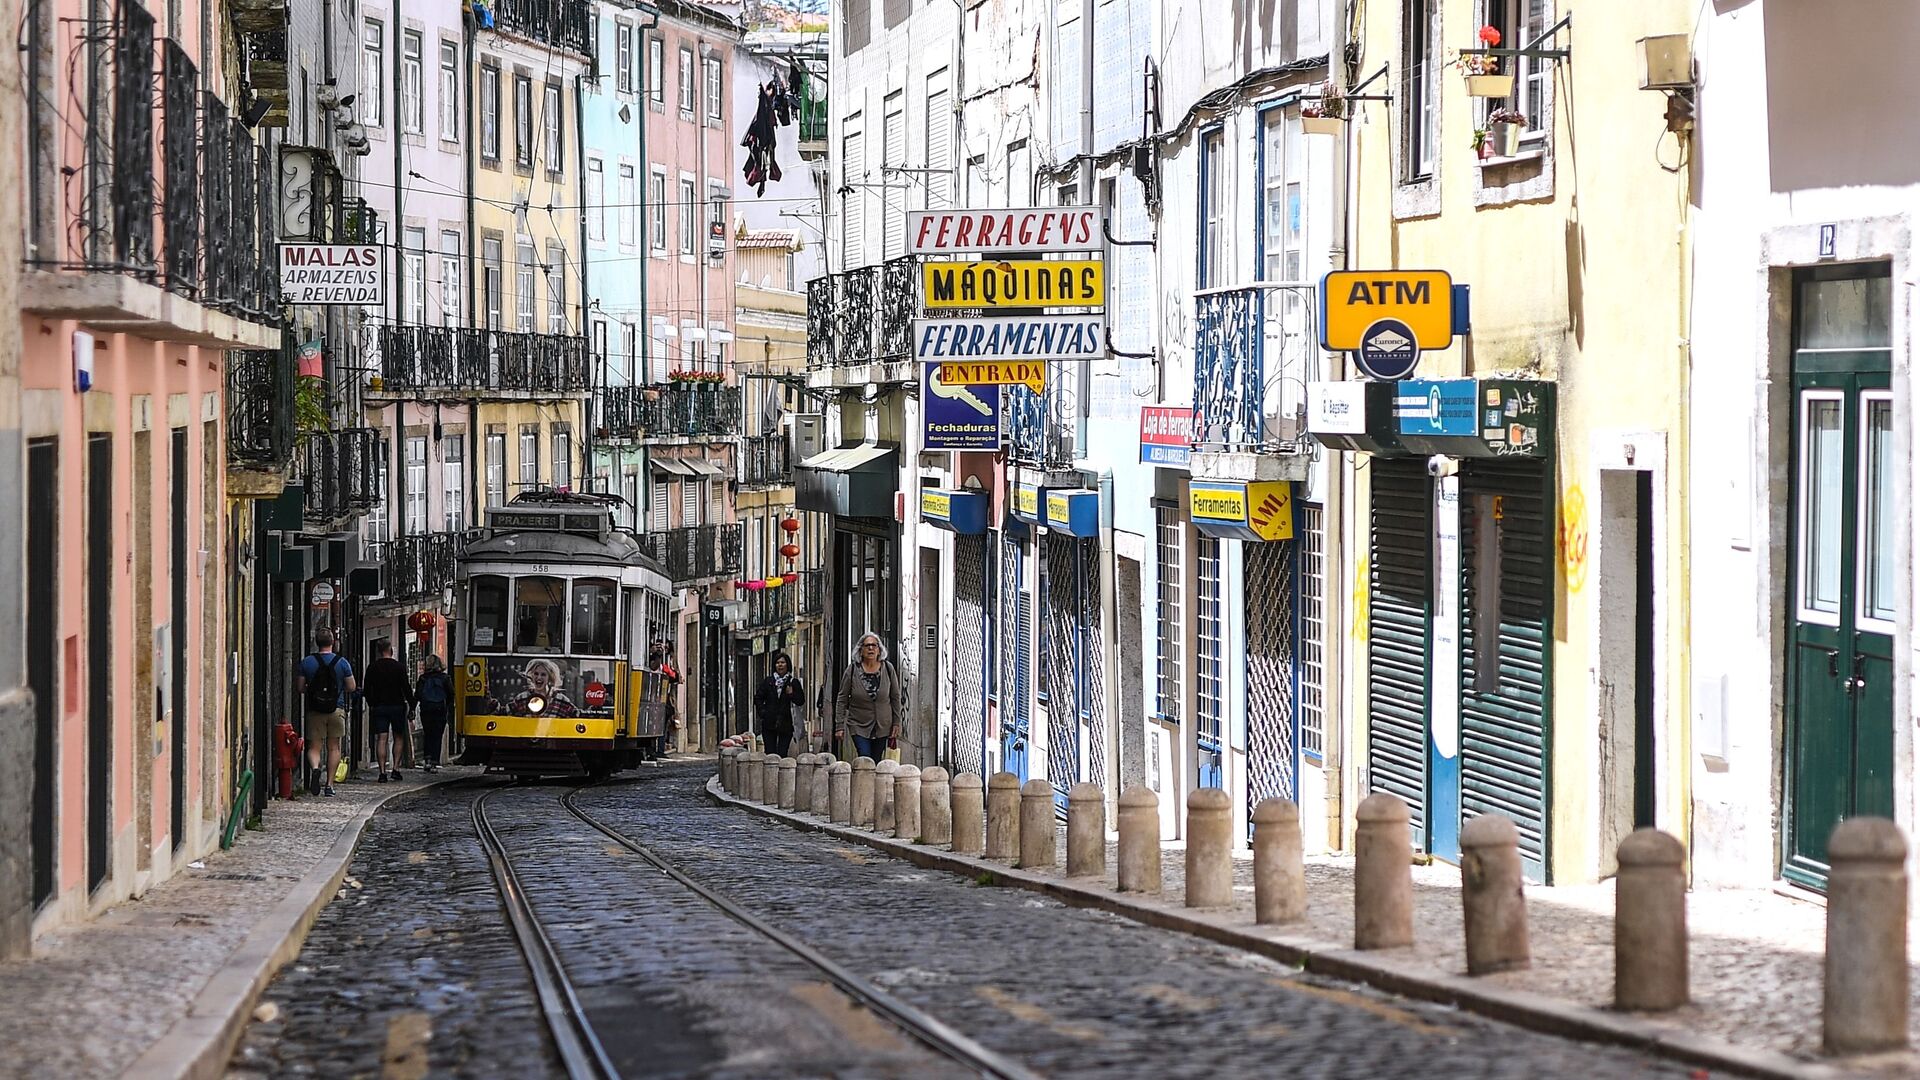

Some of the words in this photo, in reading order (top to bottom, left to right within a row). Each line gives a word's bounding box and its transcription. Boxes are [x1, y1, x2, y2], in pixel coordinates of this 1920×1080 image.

[916, 212, 1094, 248] FERRAGENS
[1823, 226, 1833, 254] 12
[285, 248, 377, 267] MALAS
[285, 270, 378, 284] ARMAZENS
[933, 263, 1095, 304] MÁQUINAS
[302, 287, 378, 302] REVENDA
[1347, 281, 1430, 305] ATM
[918, 322, 1100, 357] FERRAMENTAS
[1374, 337, 1404, 345] Euronet
[942, 364, 1042, 382] ENTRADA
[928, 423, 997, 432] Fechaduras
[1143, 408, 1158, 441] Loja
[1158, 409, 1168, 435] de
[1193, 493, 1241, 515] Ferramentas
[1251, 493, 1289, 533] AML
[498, 515, 557, 527] PRAZERES
[532, 565, 549, 573] 558
[709, 610, 720, 620] 69
